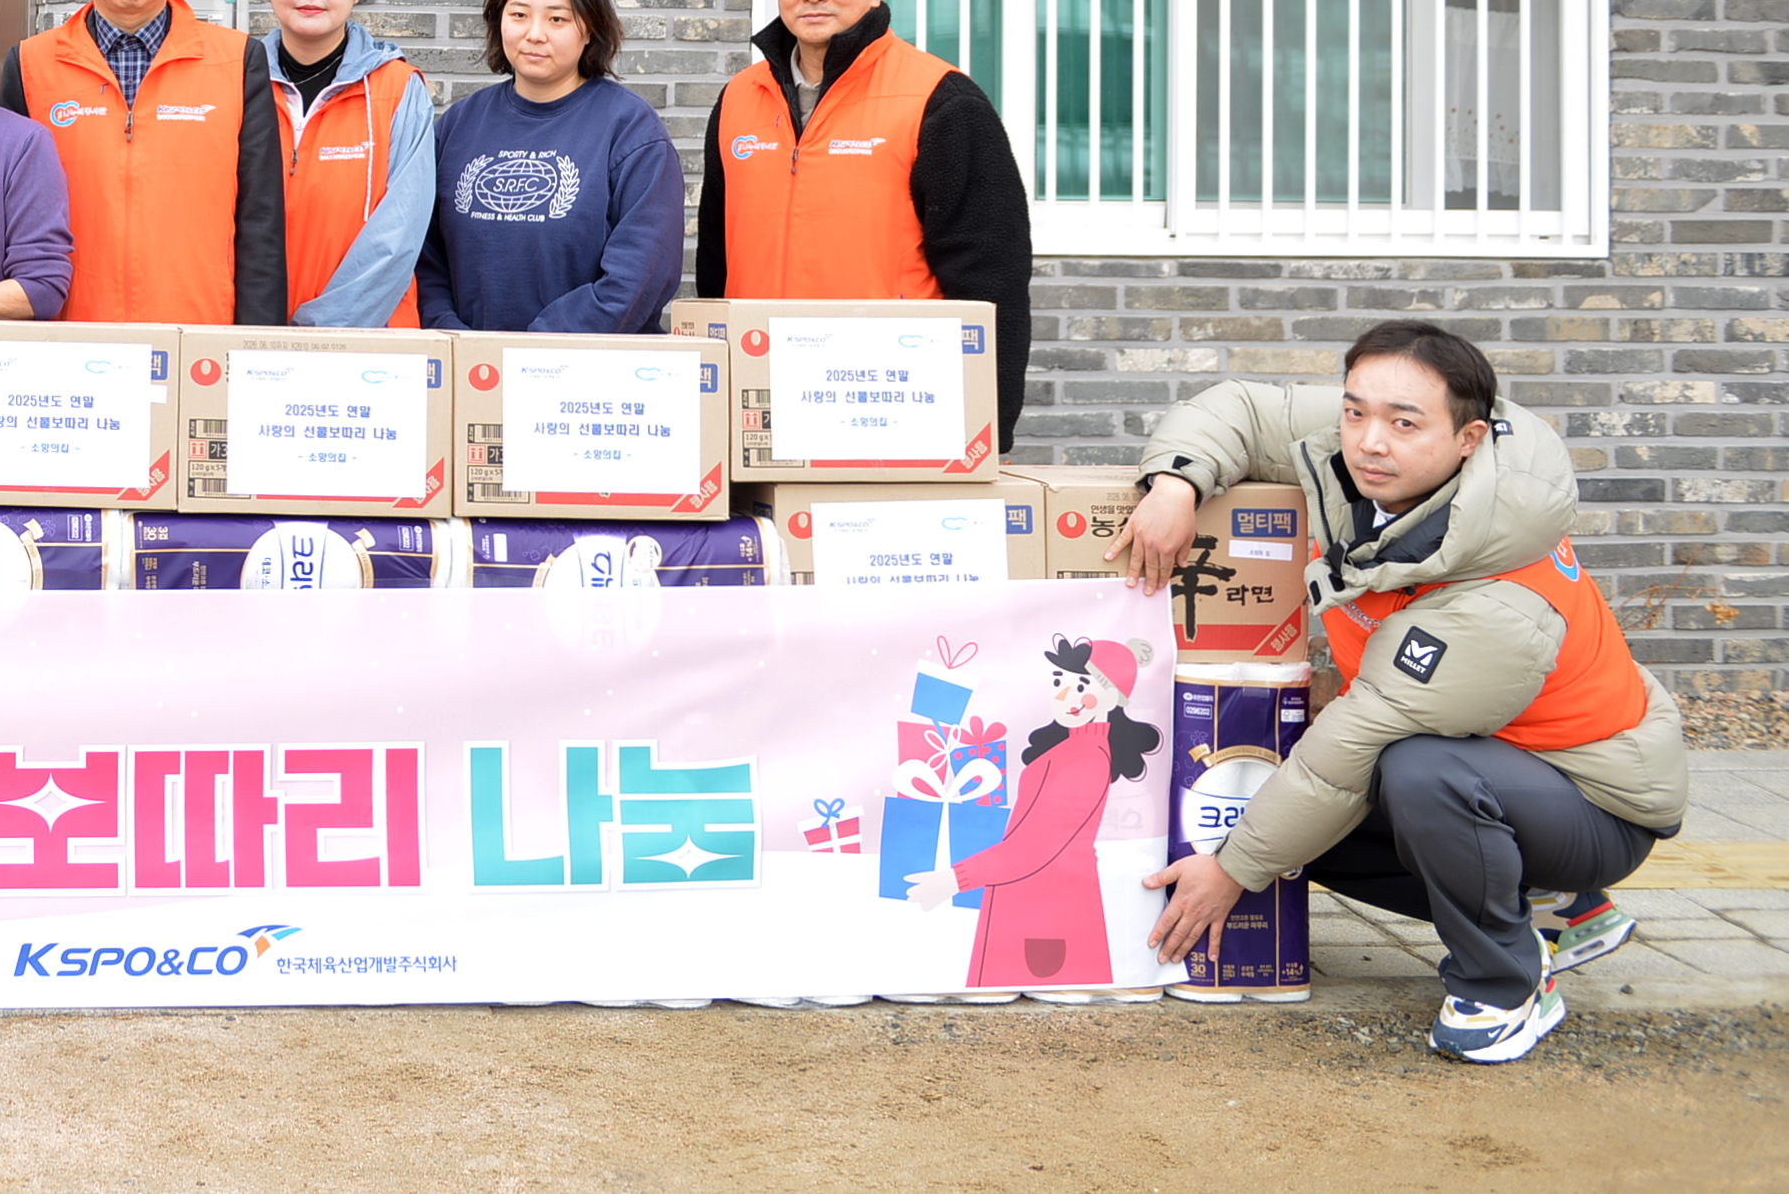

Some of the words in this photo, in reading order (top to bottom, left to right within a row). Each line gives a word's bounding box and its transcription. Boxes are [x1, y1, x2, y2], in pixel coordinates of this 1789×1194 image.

[498, 150, 528, 159] SPORTY
[529, 150, 536, 159] &
[538, 149, 557, 158] RICH
[471, 211, 495, 220] FITNESS
[504, 213, 526, 221] HEALTH
[527, 214, 546, 222] CLUB
[825, 369, 878, 383] 2025년도
[885, 369, 909, 383] 연말
[7, 394, 62, 408] 2025년도
[69, 395, 95, 409] 연말
[801, 390, 837, 404] 사랑의
[844, 390, 905, 404] 선물보따리
[911, 391, 935, 404] 나눔
[285, 403, 339, 418] 2025년도
[346, 404, 372, 419] 연말
[559, 401, 614, 415] 2025년도
[620, 402, 646, 416] 연말
[26, 416, 89, 430] 선물보따리
[96, 417, 121, 431] 나눔
[851, 416, 888, 428] 소망의집
[258, 424, 295, 438] 사랑의
[303, 425, 366, 440] 선물보따리
[373, 427, 397, 441] 나눔
[533, 422, 570, 436] 사랑의
[578, 422, 640, 437] 선물보따리
[647, 424, 671, 438] 나눔
[31, 442, 70, 454] 소망의집
[584, 449, 622, 461] 소망의집
[308, 452, 347, 464] 소망의집
[1090, 505, 1115, 515] 인생을
[1237, 512, 1292, 533] 멀티팩
[147, 526, 157, 540] 30
[869, 553, 922, 567] 2025년도
[929, 552, 954, 566] 연말
[1225, 584, 1275, 606] 라면
[1270, 623, 1297, 652] 행사용
[1400, 655, 1427, 674] MILLET
[469, 746, 756, 887] 나눔
[13, 943, 248, 977] KSPO&CO
[276, 955, 457, 975] 한국체육산업개발주식회사
[1191, 963, 1206, 974] 30
